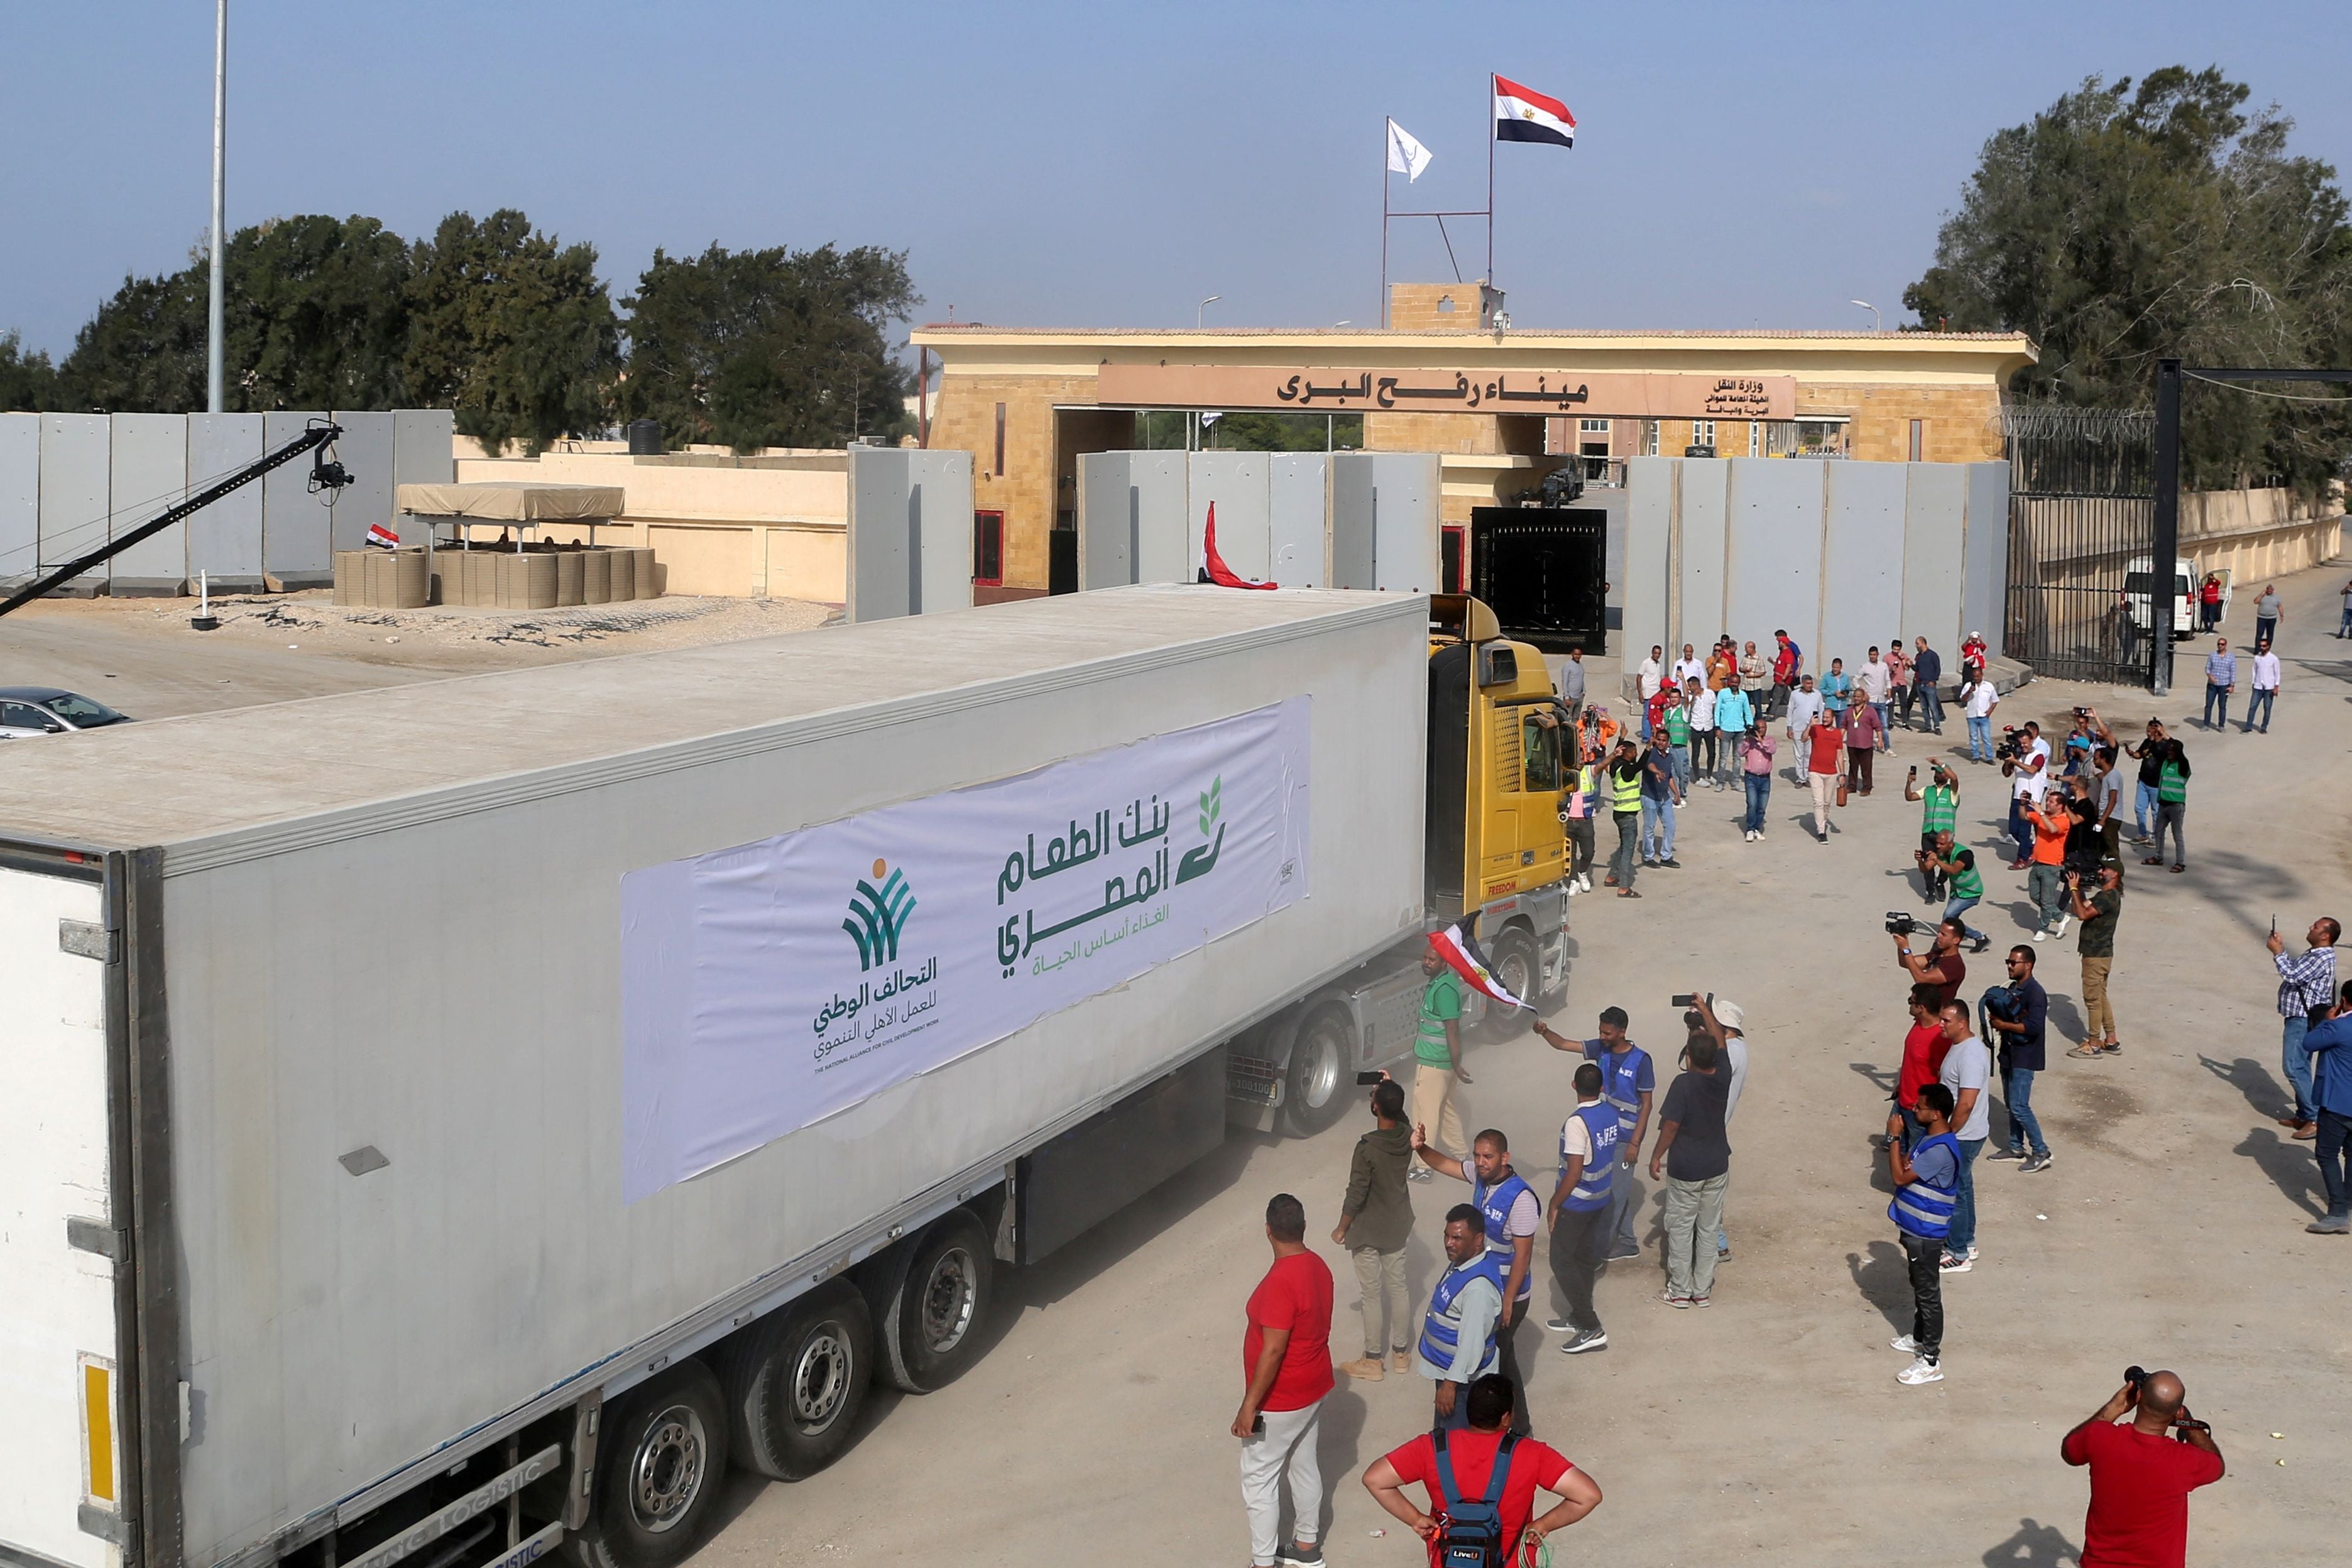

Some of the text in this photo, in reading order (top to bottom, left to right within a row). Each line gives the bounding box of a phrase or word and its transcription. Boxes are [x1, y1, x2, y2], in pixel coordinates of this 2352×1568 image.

[1376, 371, 1480, 408] رفح
[1485, 375, 1589, 410] ميناء
[1713, 379, 1763, 393] وزارة النقل
[998, 794, 1169, 906] بنك الطعام
[998, 847, 1169, 979] المصري
[1489, 880, 1516, 896] FREEDOM
[1032, 903, 1169, 976] الغذاء أساس الحياة
[813, 956, 937, 1038] التحالف الوطني
[814, 990, 936, 1062] للعمل الأهلي التنموي
[814, 1018, 939, 1075] THE NATIONAL ALLIANCE FOR CIVIL DEVELOPMENT WORK
[439, 1462, 541, 1534] LOGISTIC
